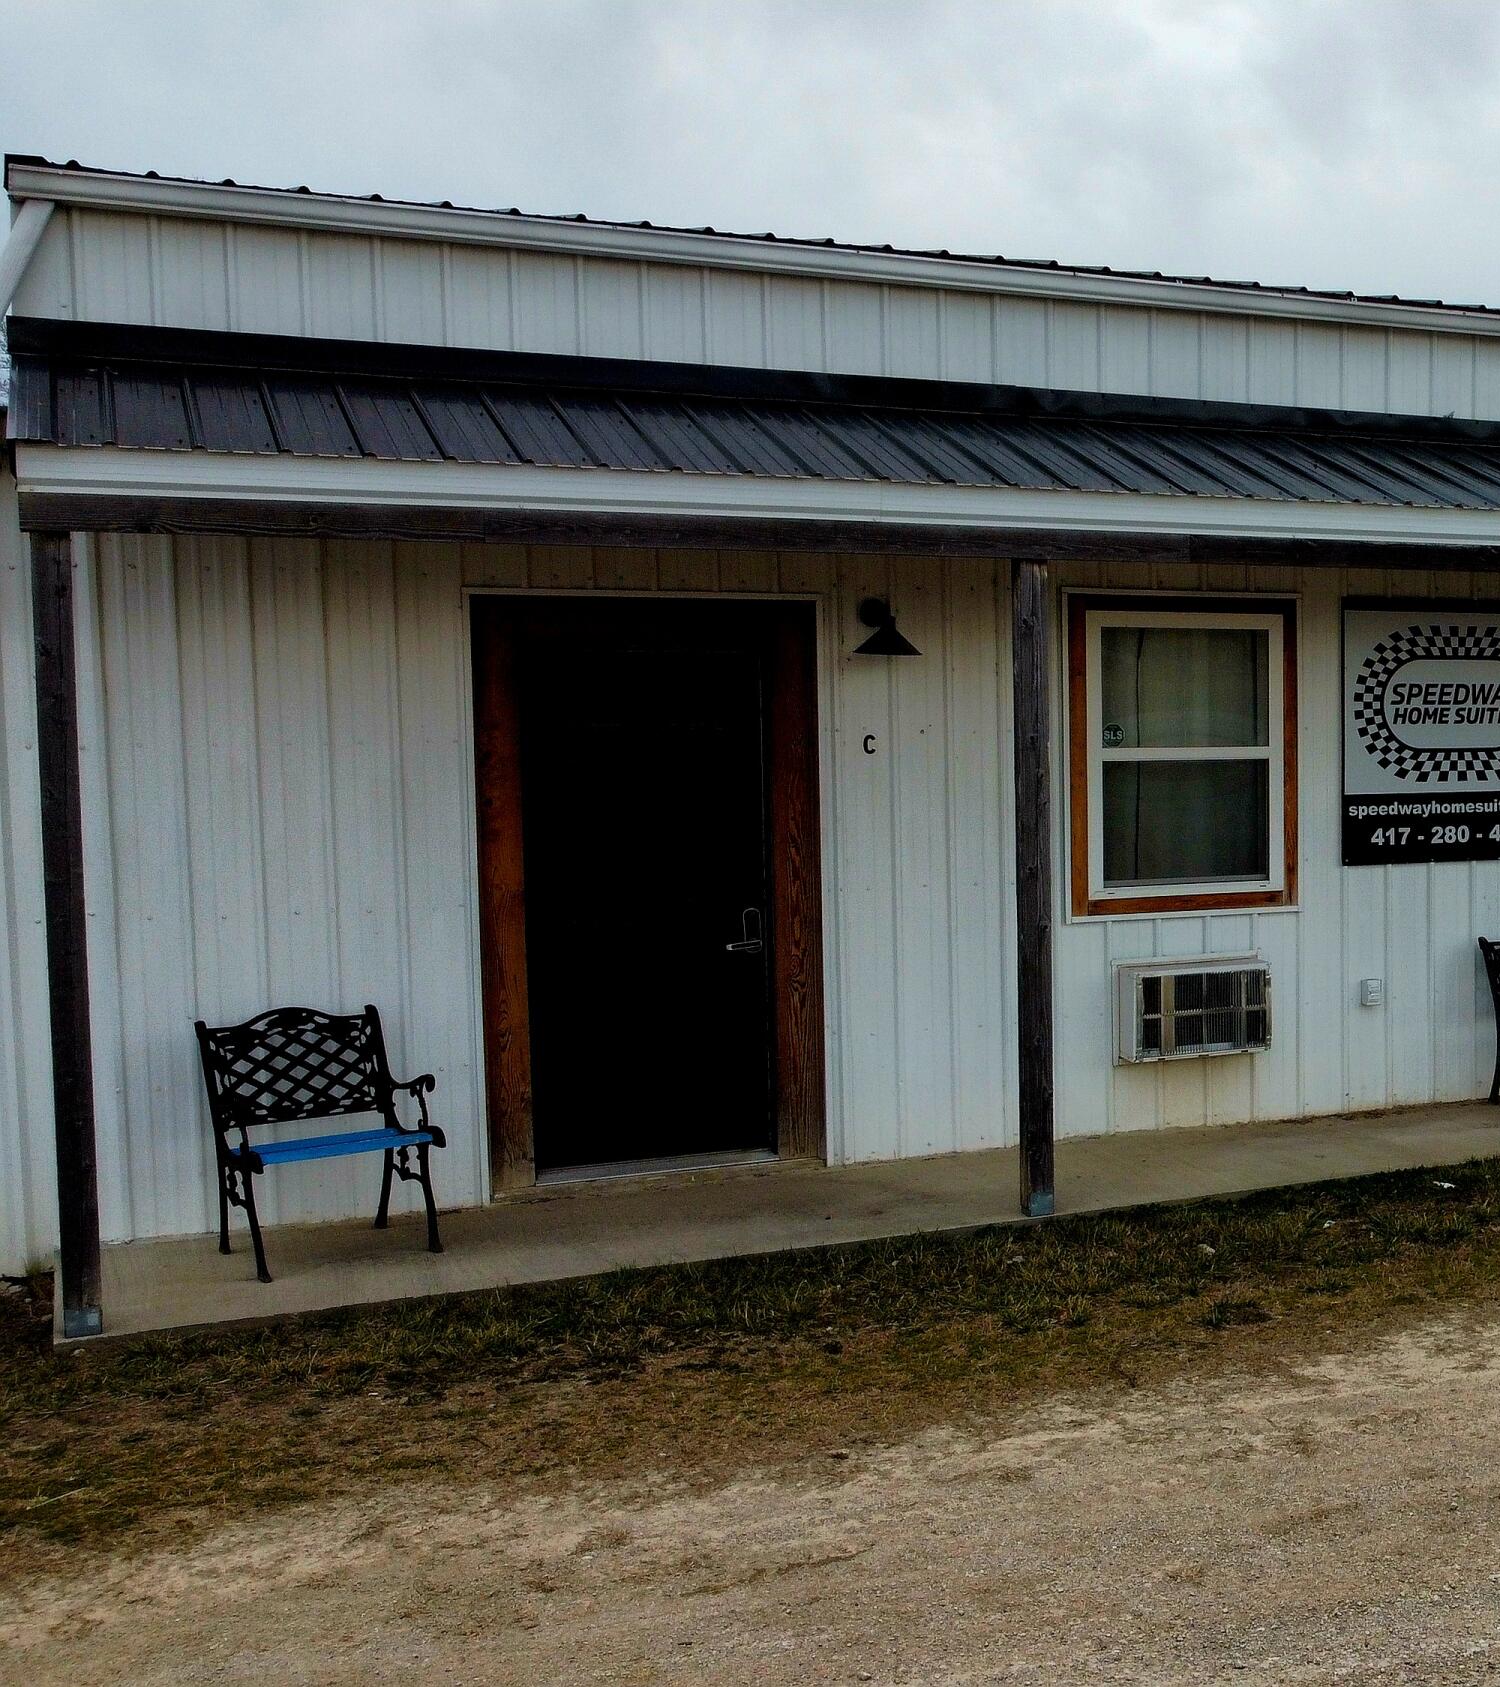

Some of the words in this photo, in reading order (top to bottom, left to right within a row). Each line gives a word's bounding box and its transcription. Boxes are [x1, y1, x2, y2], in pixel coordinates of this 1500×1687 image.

[1392, 707, 1450, 725] HOME
[863, 734, 876, 755] C
[1103, 730, 1123, 740] SLS
[1371, 827, 1411, 846] 417
[1431, 825, 1470, 844] 280
